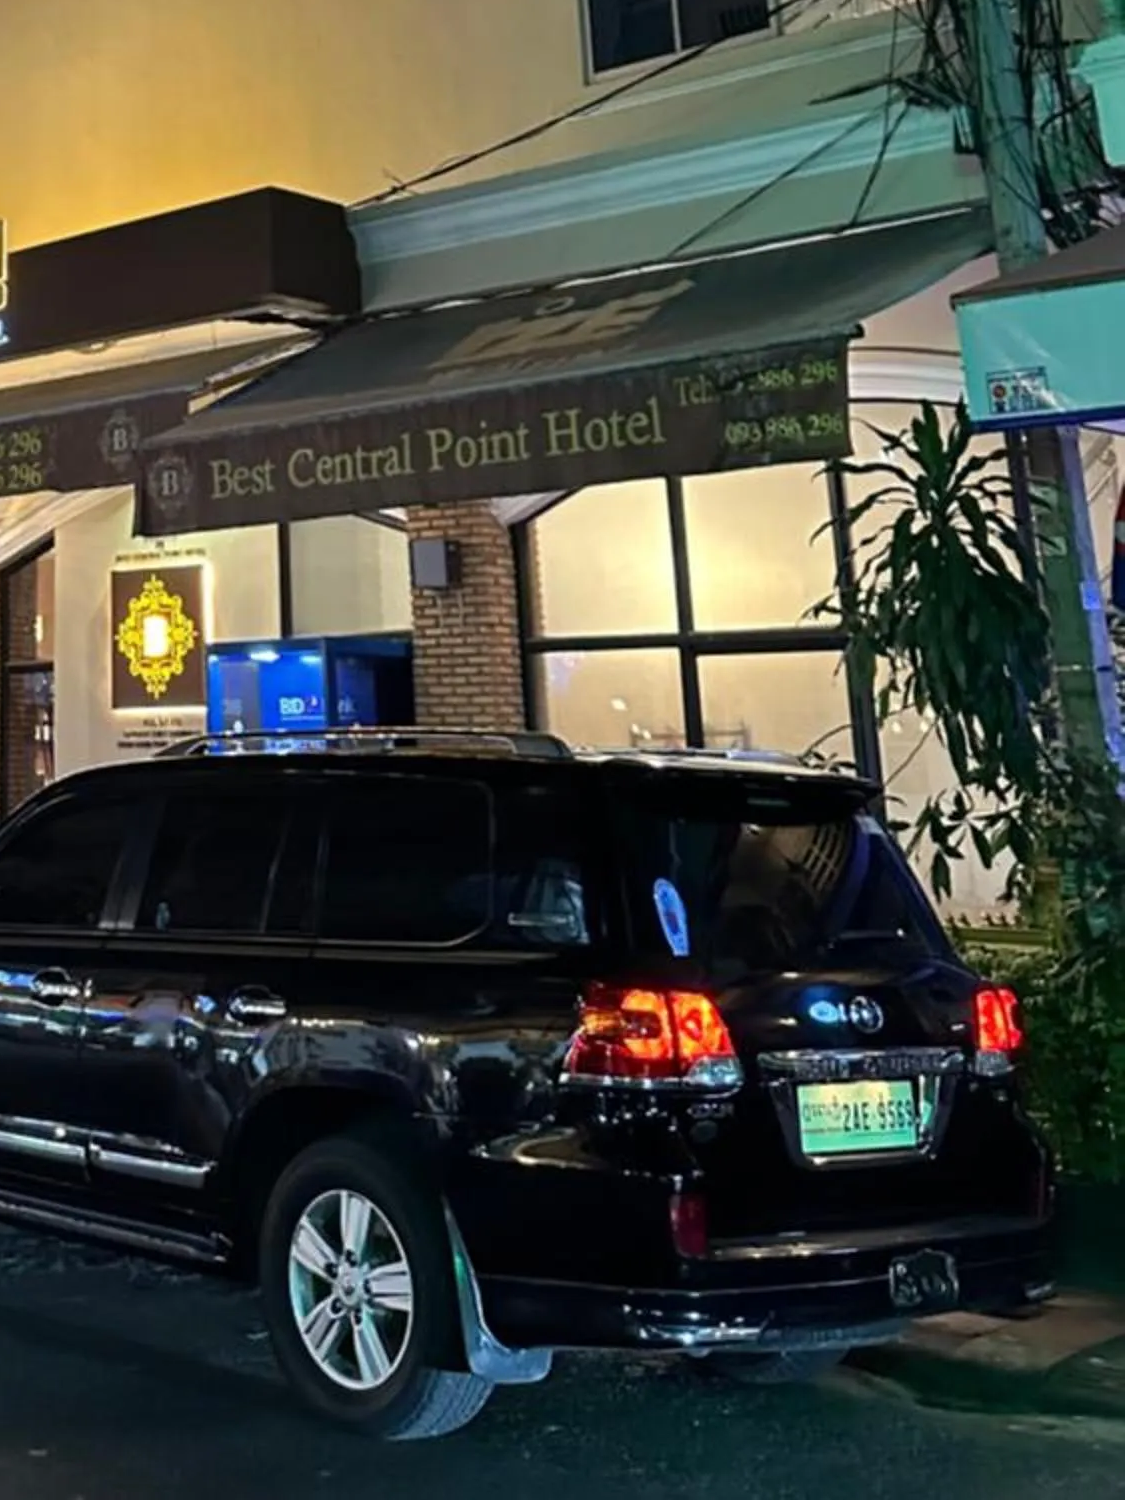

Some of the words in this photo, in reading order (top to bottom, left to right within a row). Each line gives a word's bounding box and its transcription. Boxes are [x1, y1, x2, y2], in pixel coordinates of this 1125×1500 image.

[8, 427, 43, 456] 296
[209, 458, 276, 499] Best
[287, 432, 416, 489] Central
[426, 420, 531, 473] Point
[541, 395, 667, 457] Hotel
[8, 462, 43, 489] 296
